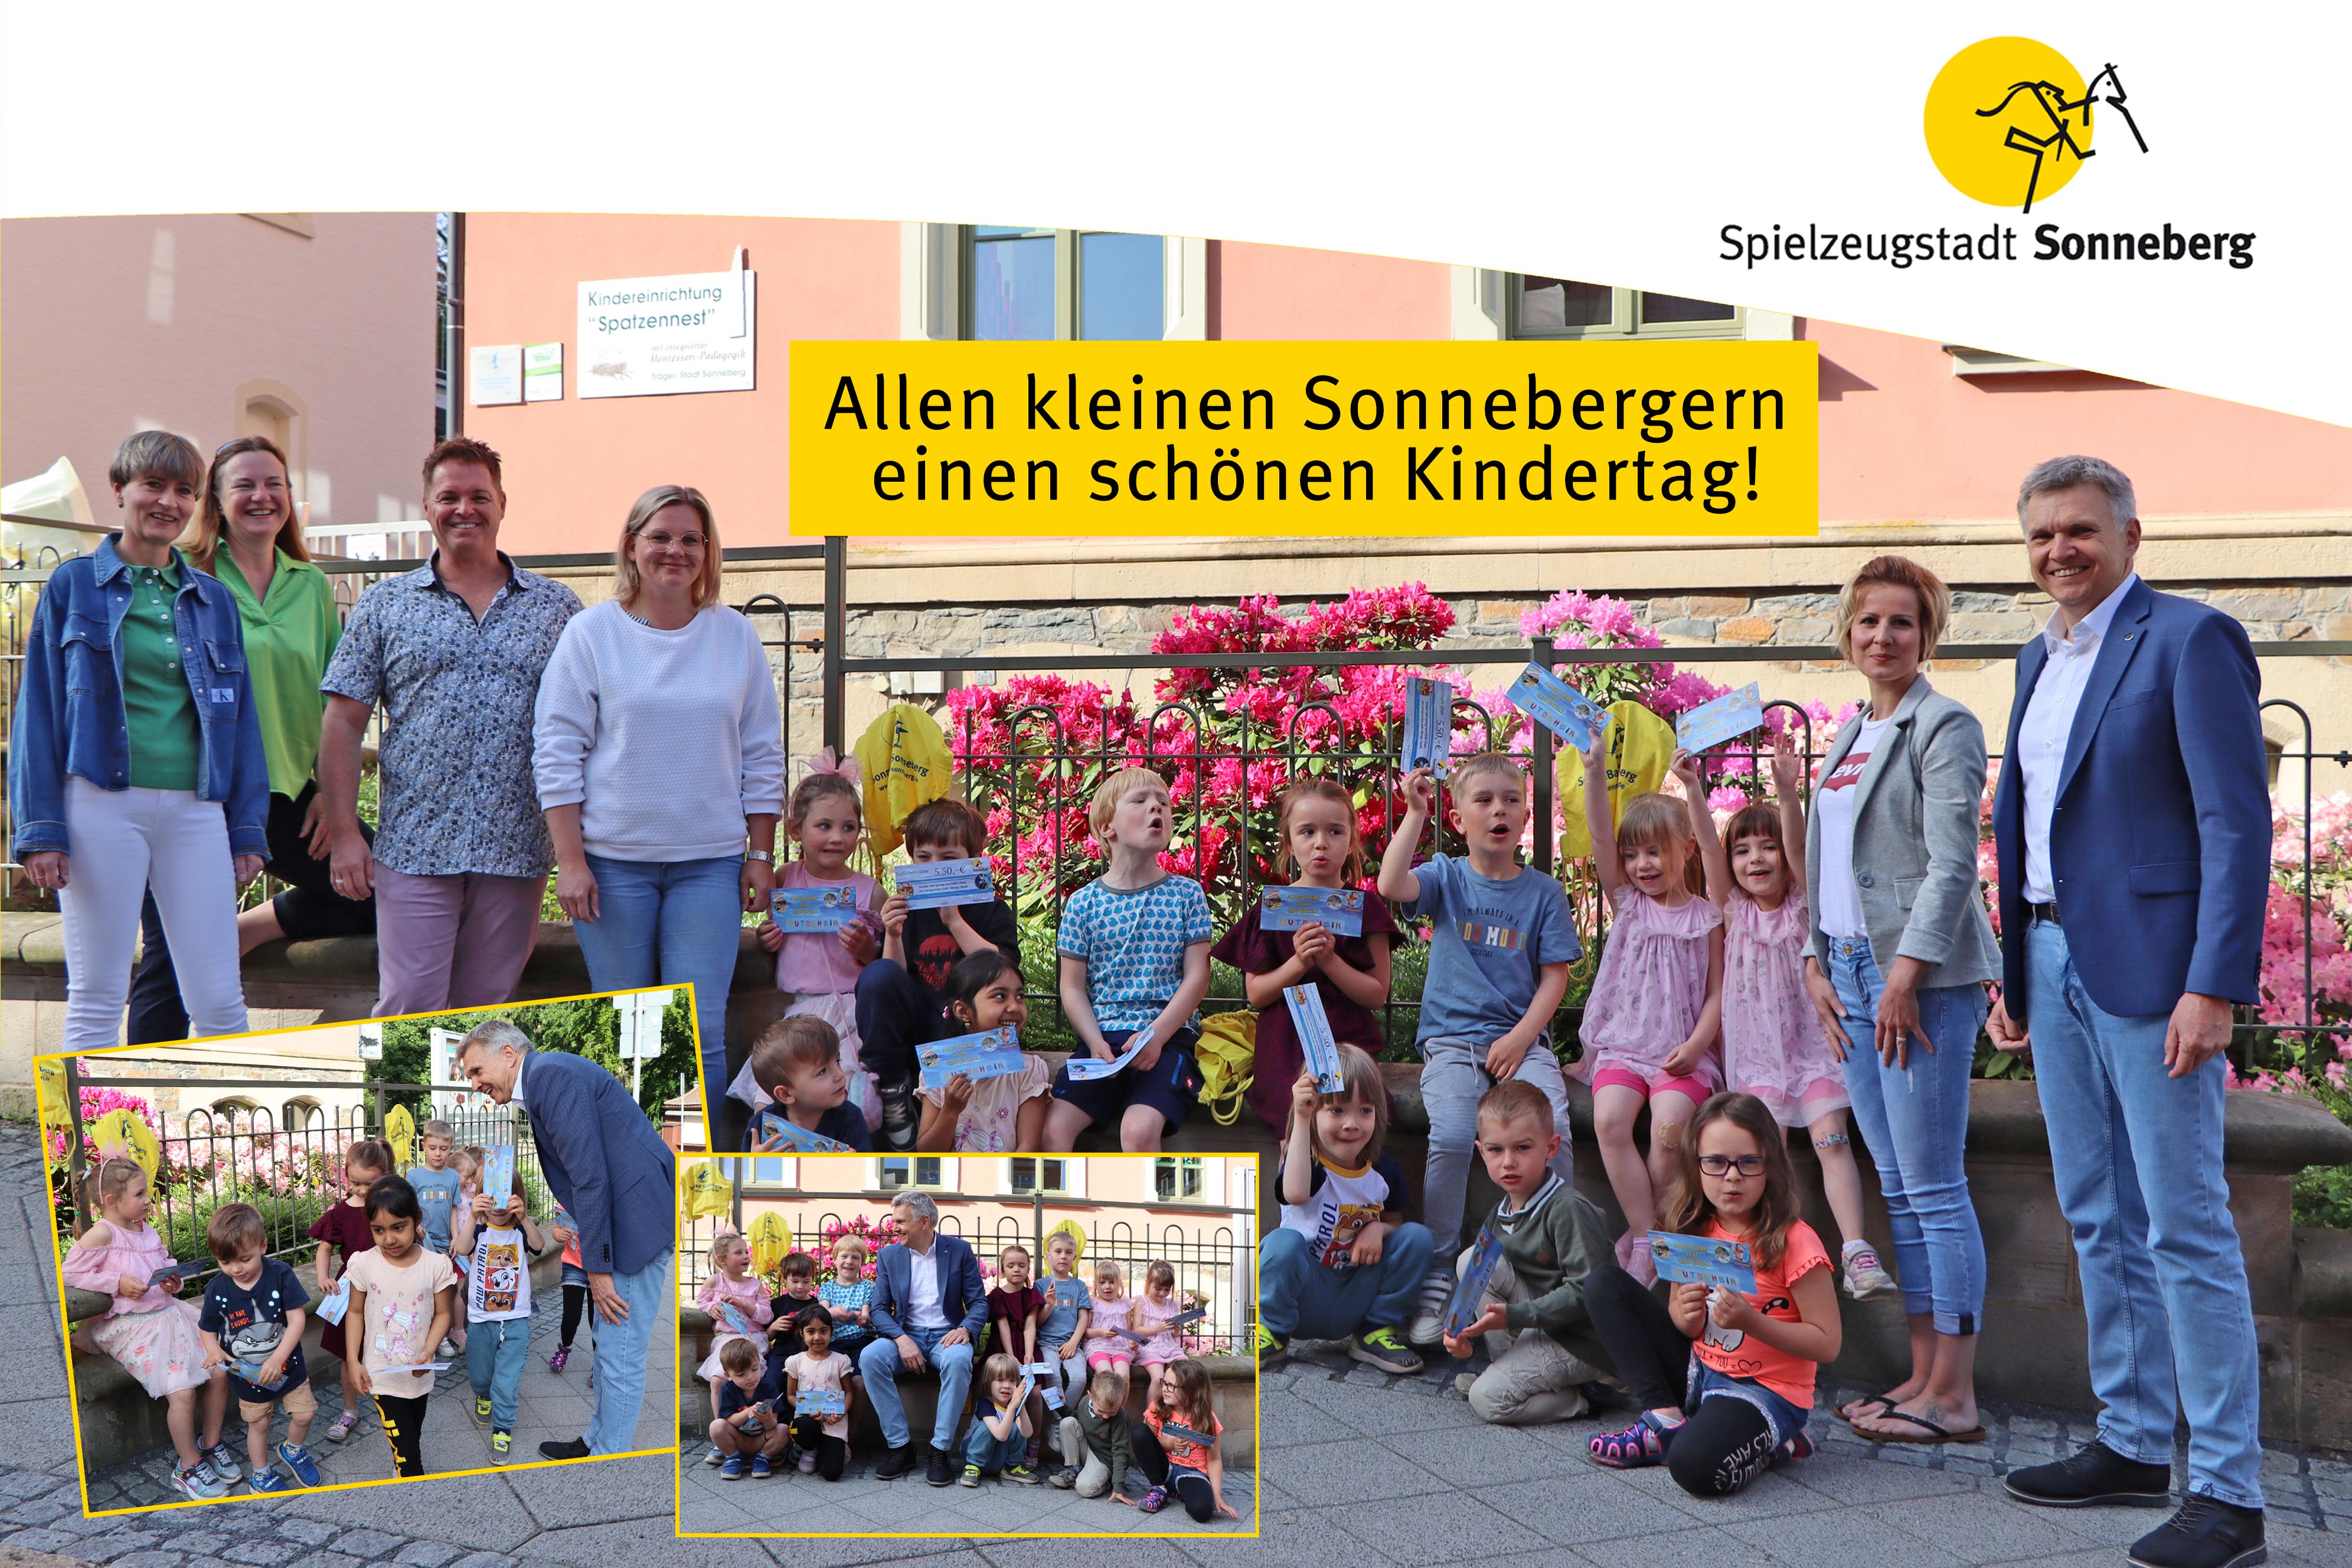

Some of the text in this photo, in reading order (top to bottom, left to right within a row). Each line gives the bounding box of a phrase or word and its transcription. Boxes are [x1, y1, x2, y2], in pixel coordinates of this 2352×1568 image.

[589, 288, 721, 306] Kindereinrichtung
[680, 370, 700, 379] Stadt
[702, 368, 746, 378] Sonneberg
[935, 865, 966, 877] 5.50,-€
[1476, 907, 1504, 919] ALWAYS
[1455, 917, 1527, 951] OOD MOOD
[1309, 1203, 1337, 1260] PATROL
[476, 1243, 488, 1310] PAW PATROL
